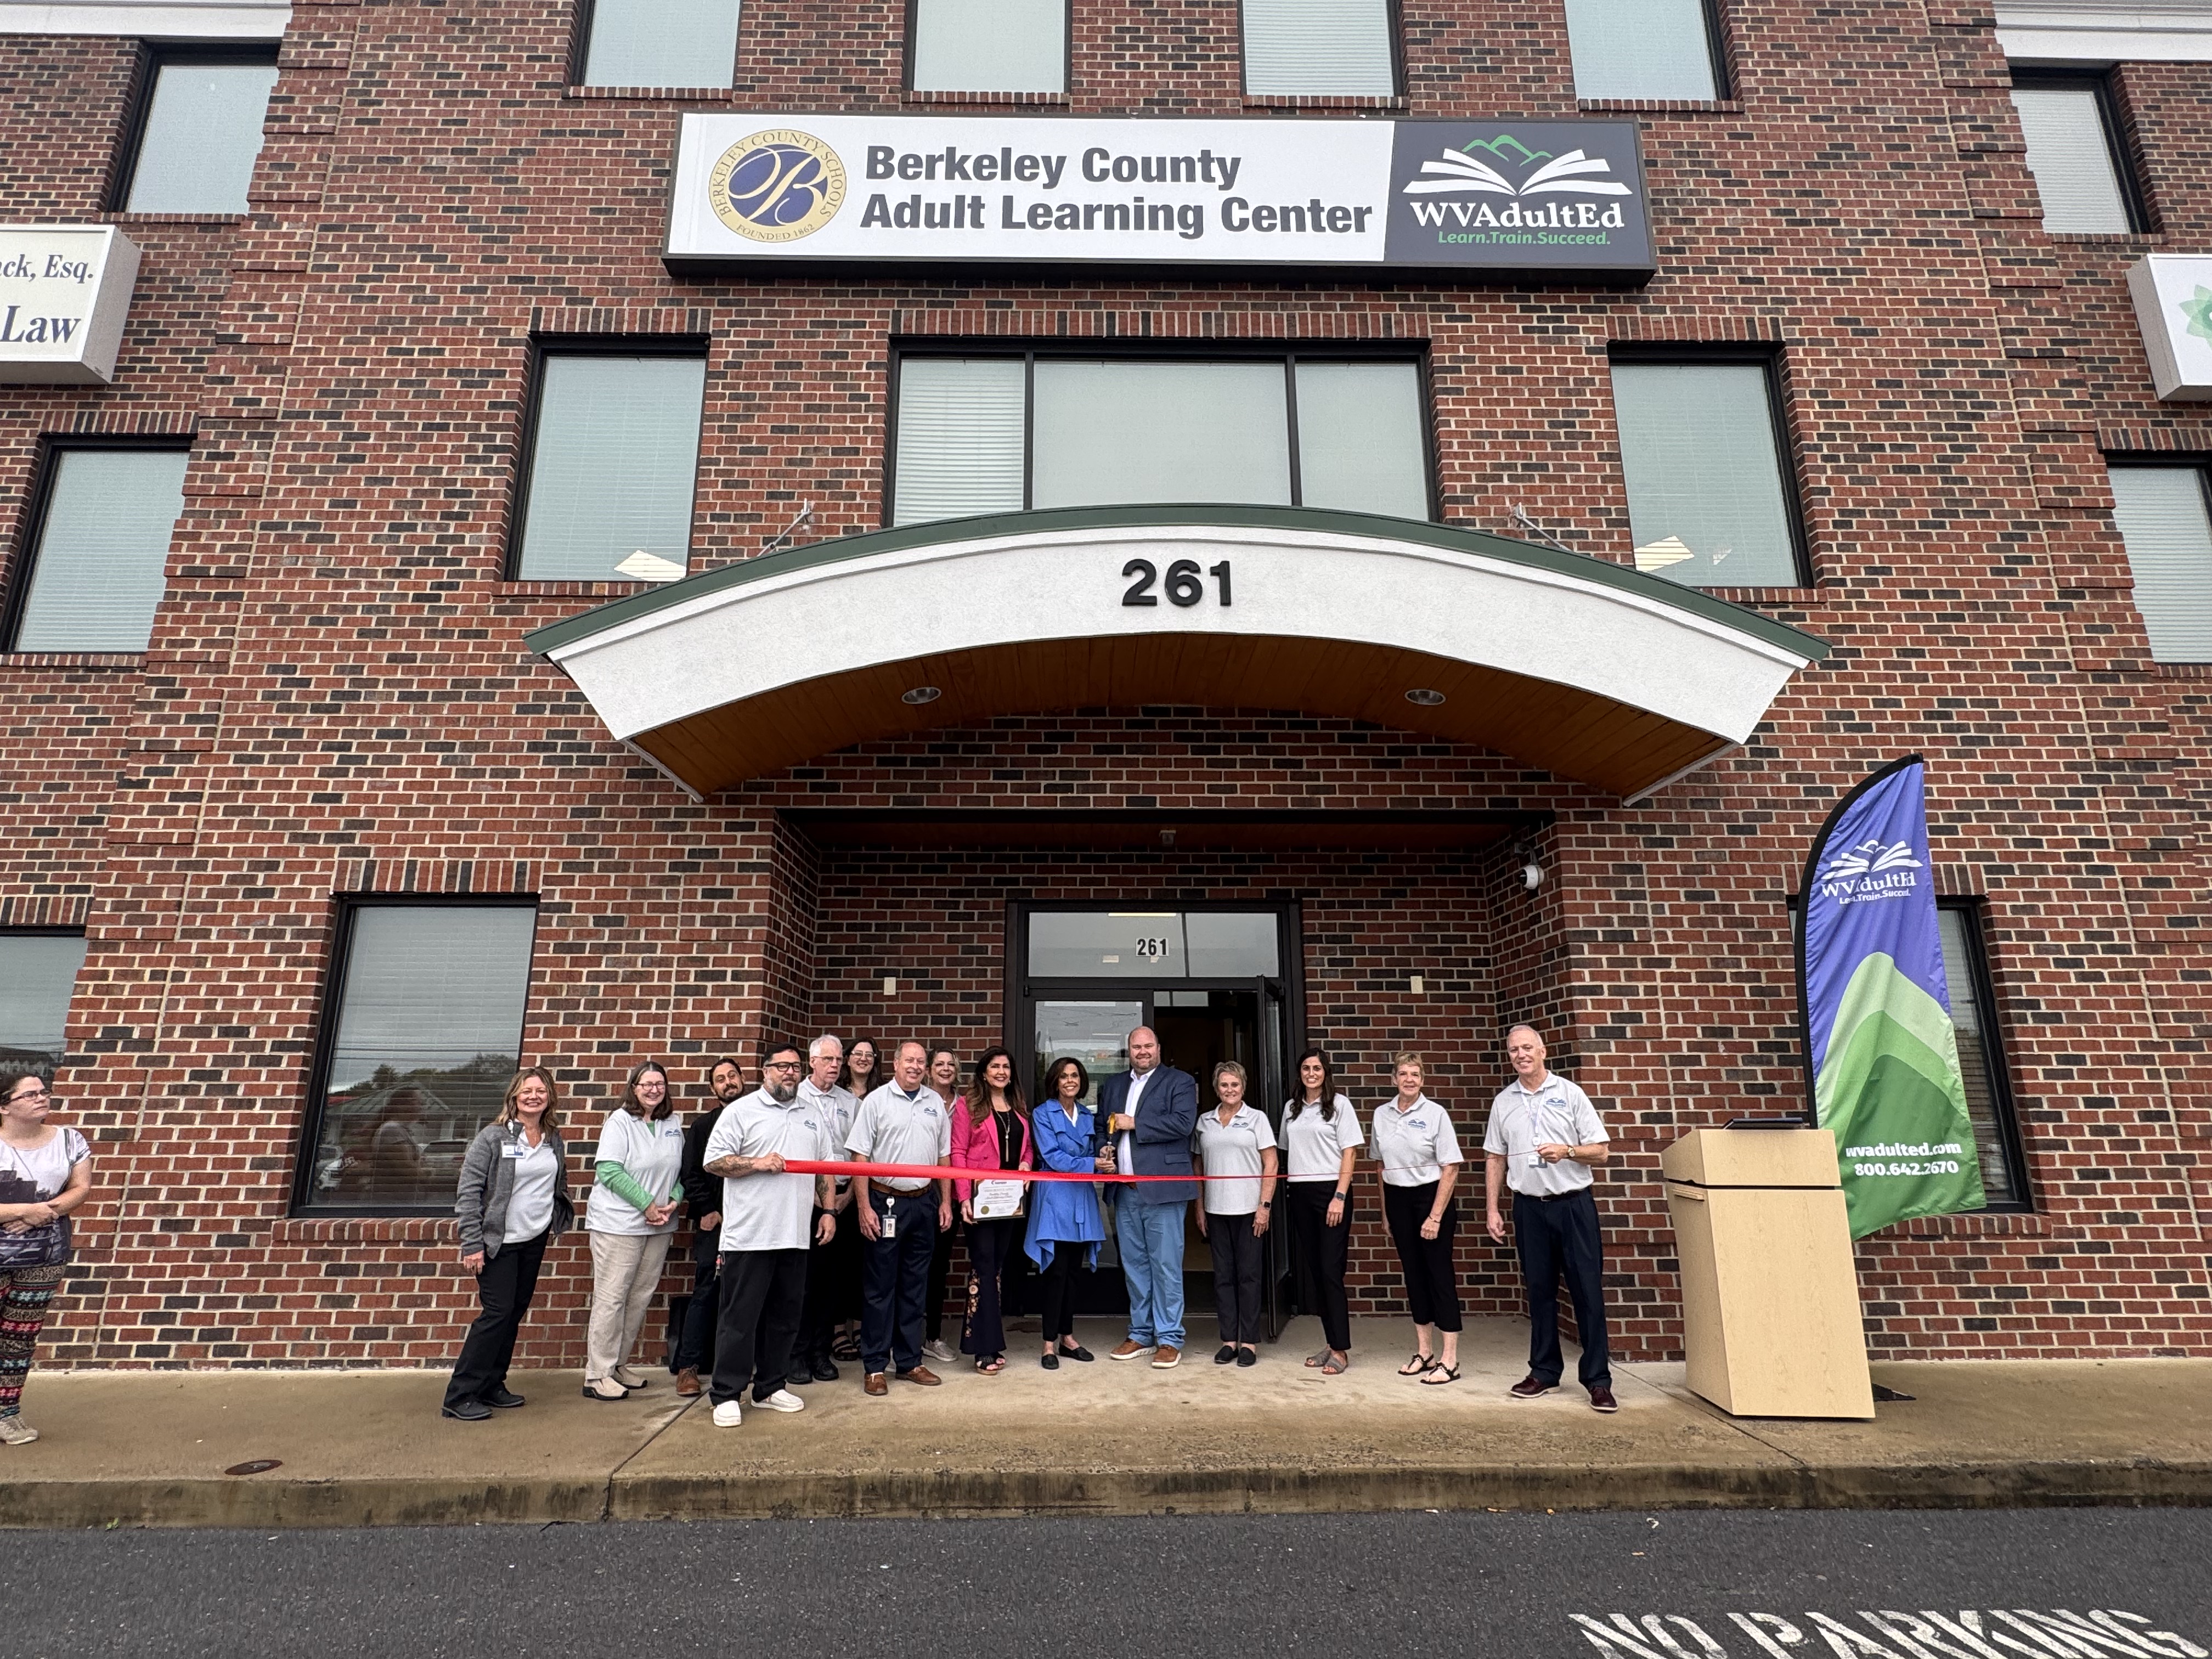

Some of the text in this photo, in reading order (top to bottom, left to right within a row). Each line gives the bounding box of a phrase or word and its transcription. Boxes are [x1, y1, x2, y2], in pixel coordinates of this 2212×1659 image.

[713, 132, 844, 217] BERKELEY COUNTY SCHOOLS
[866, 145, 1242, 191] Berkeley County
[860, 194, 1373, 240] Adult Learning Center
[1410, 202, 1625, 228] WVAdultEd
[736, 224, 815, 240] FOUNDED 1862
[1438, 230, 1611, 245] Learn.Train.Succeed.
[0, 253, 93, 284] ck, Esq.
[0, 306, 82, 343] Law
[1122, 558, 1232, 607] 261
[1137, 938, 1166, 956] 261
[1846, 1142, 1963, 1158] wvadulted.com
[1854, 1160, 1960, 1176] 800.642.2670
[1567, 1609, 2210, 1659] NO PARKING
